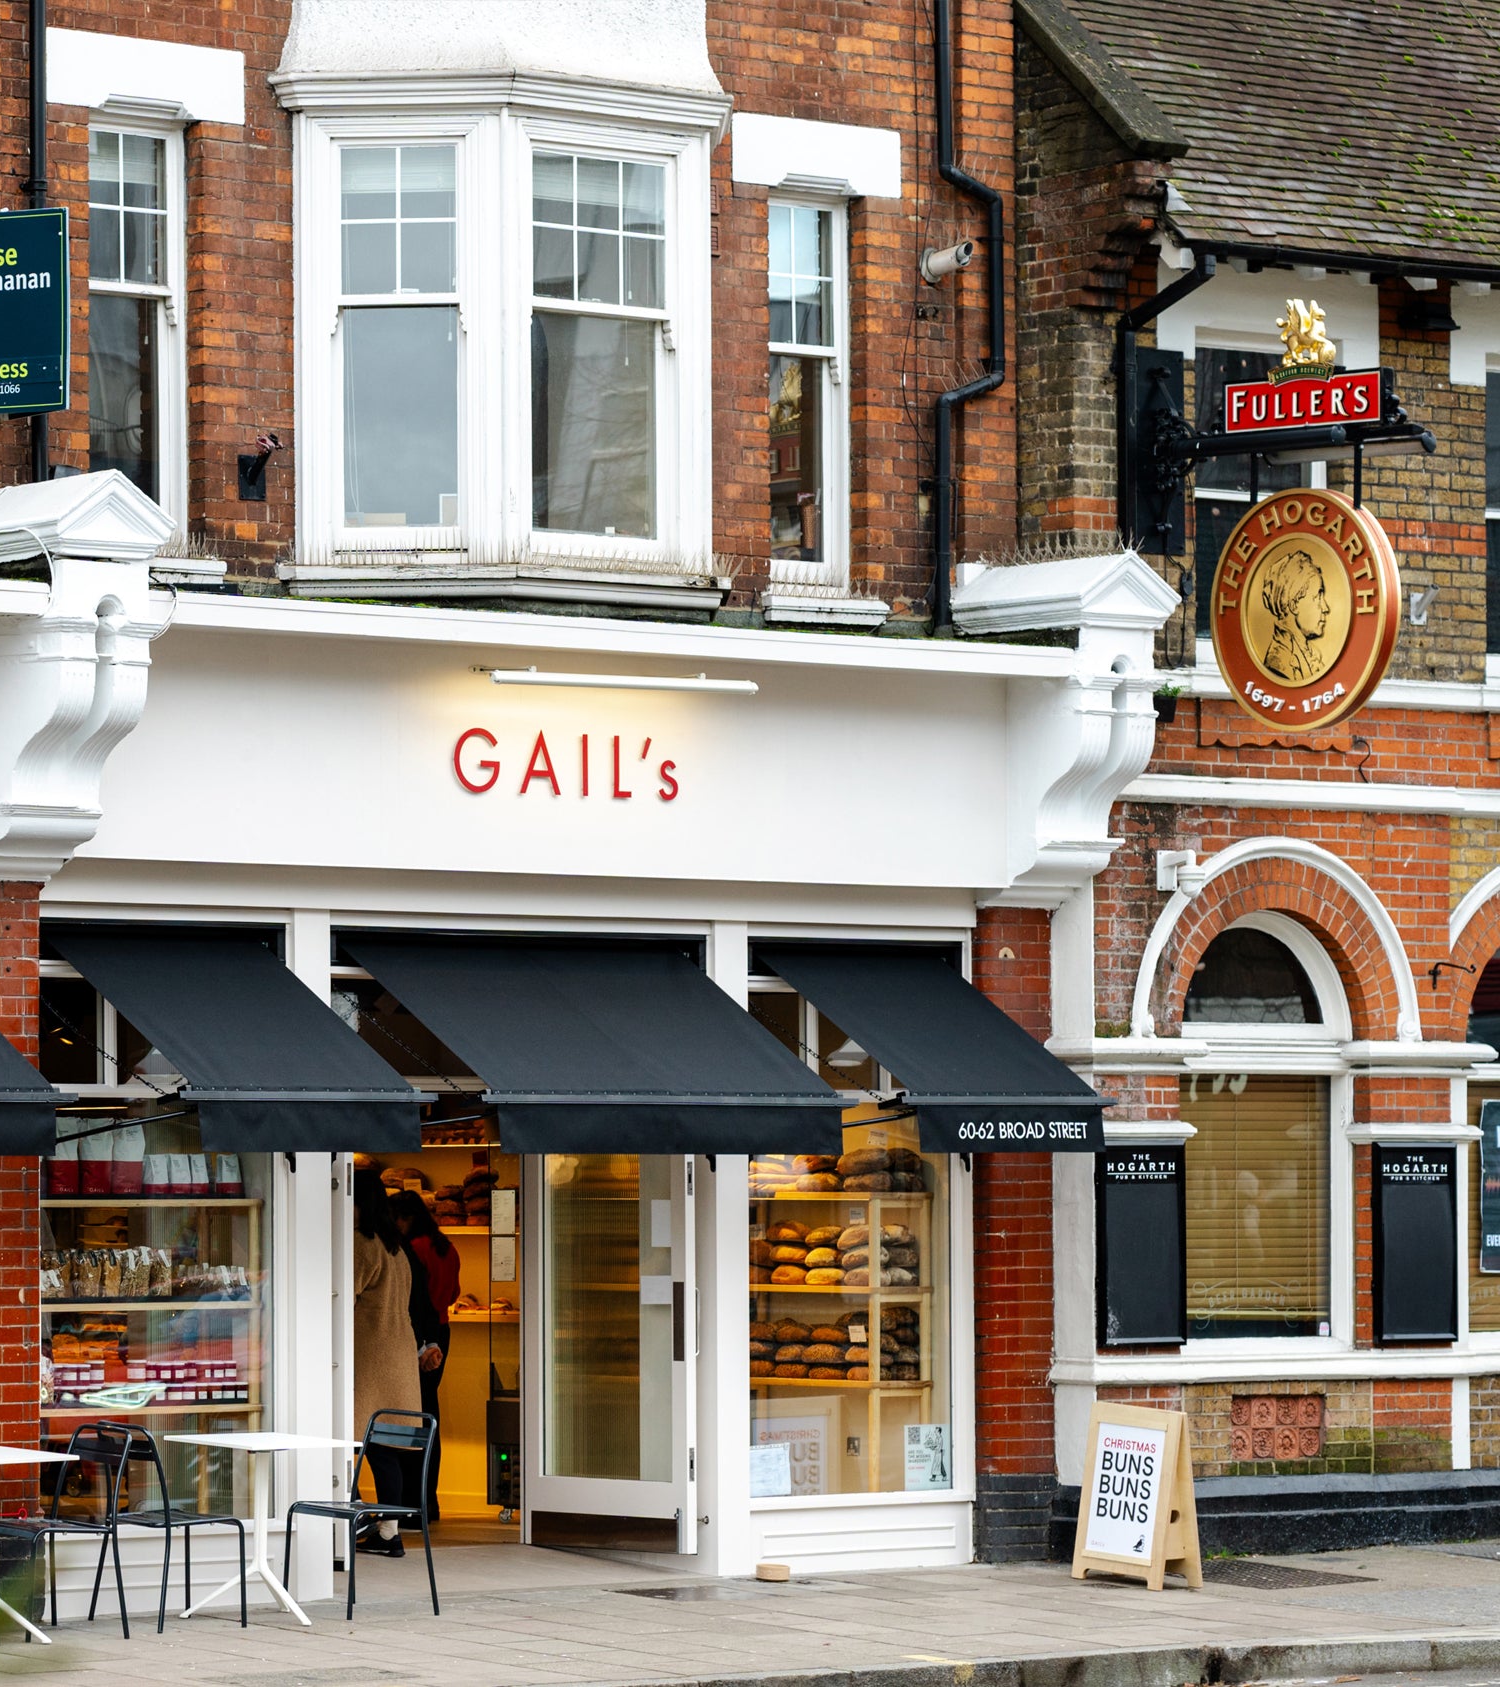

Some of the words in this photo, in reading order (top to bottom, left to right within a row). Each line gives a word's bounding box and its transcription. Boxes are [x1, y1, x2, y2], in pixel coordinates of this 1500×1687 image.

[0, 384, 20, 394] 1066
[1231, 382, 1370, 424] FULLER'S
[1218, 532, 1258, 616] THE
[1257, 499, 1377, 616] HOGARTH
[1244, 680, 1286, 713] 1697
[1301, 681, 1347, 713] 1764
[453, 727, 679, 801] GAIL's
[958, 1121, 995, 1140] 60-62
[999, 1121, 1045, 1139] BROAD
[1049, 1121, 1088, 1139] STREET
[1107, 1162, 1176, 1172] HOGARTH
[1132, 1153, 1150, 1161] THE
[1382, 1163, 1448, 1173] HOGARTH
[1103, 1437, 1156, 1453] CHRISTMAS
[1101, 1450, 1154, 1476] BUNS
[1099, 1474, 1151, 1500] BUNS
[1096, 1497, 1149, 1523] BUNS
